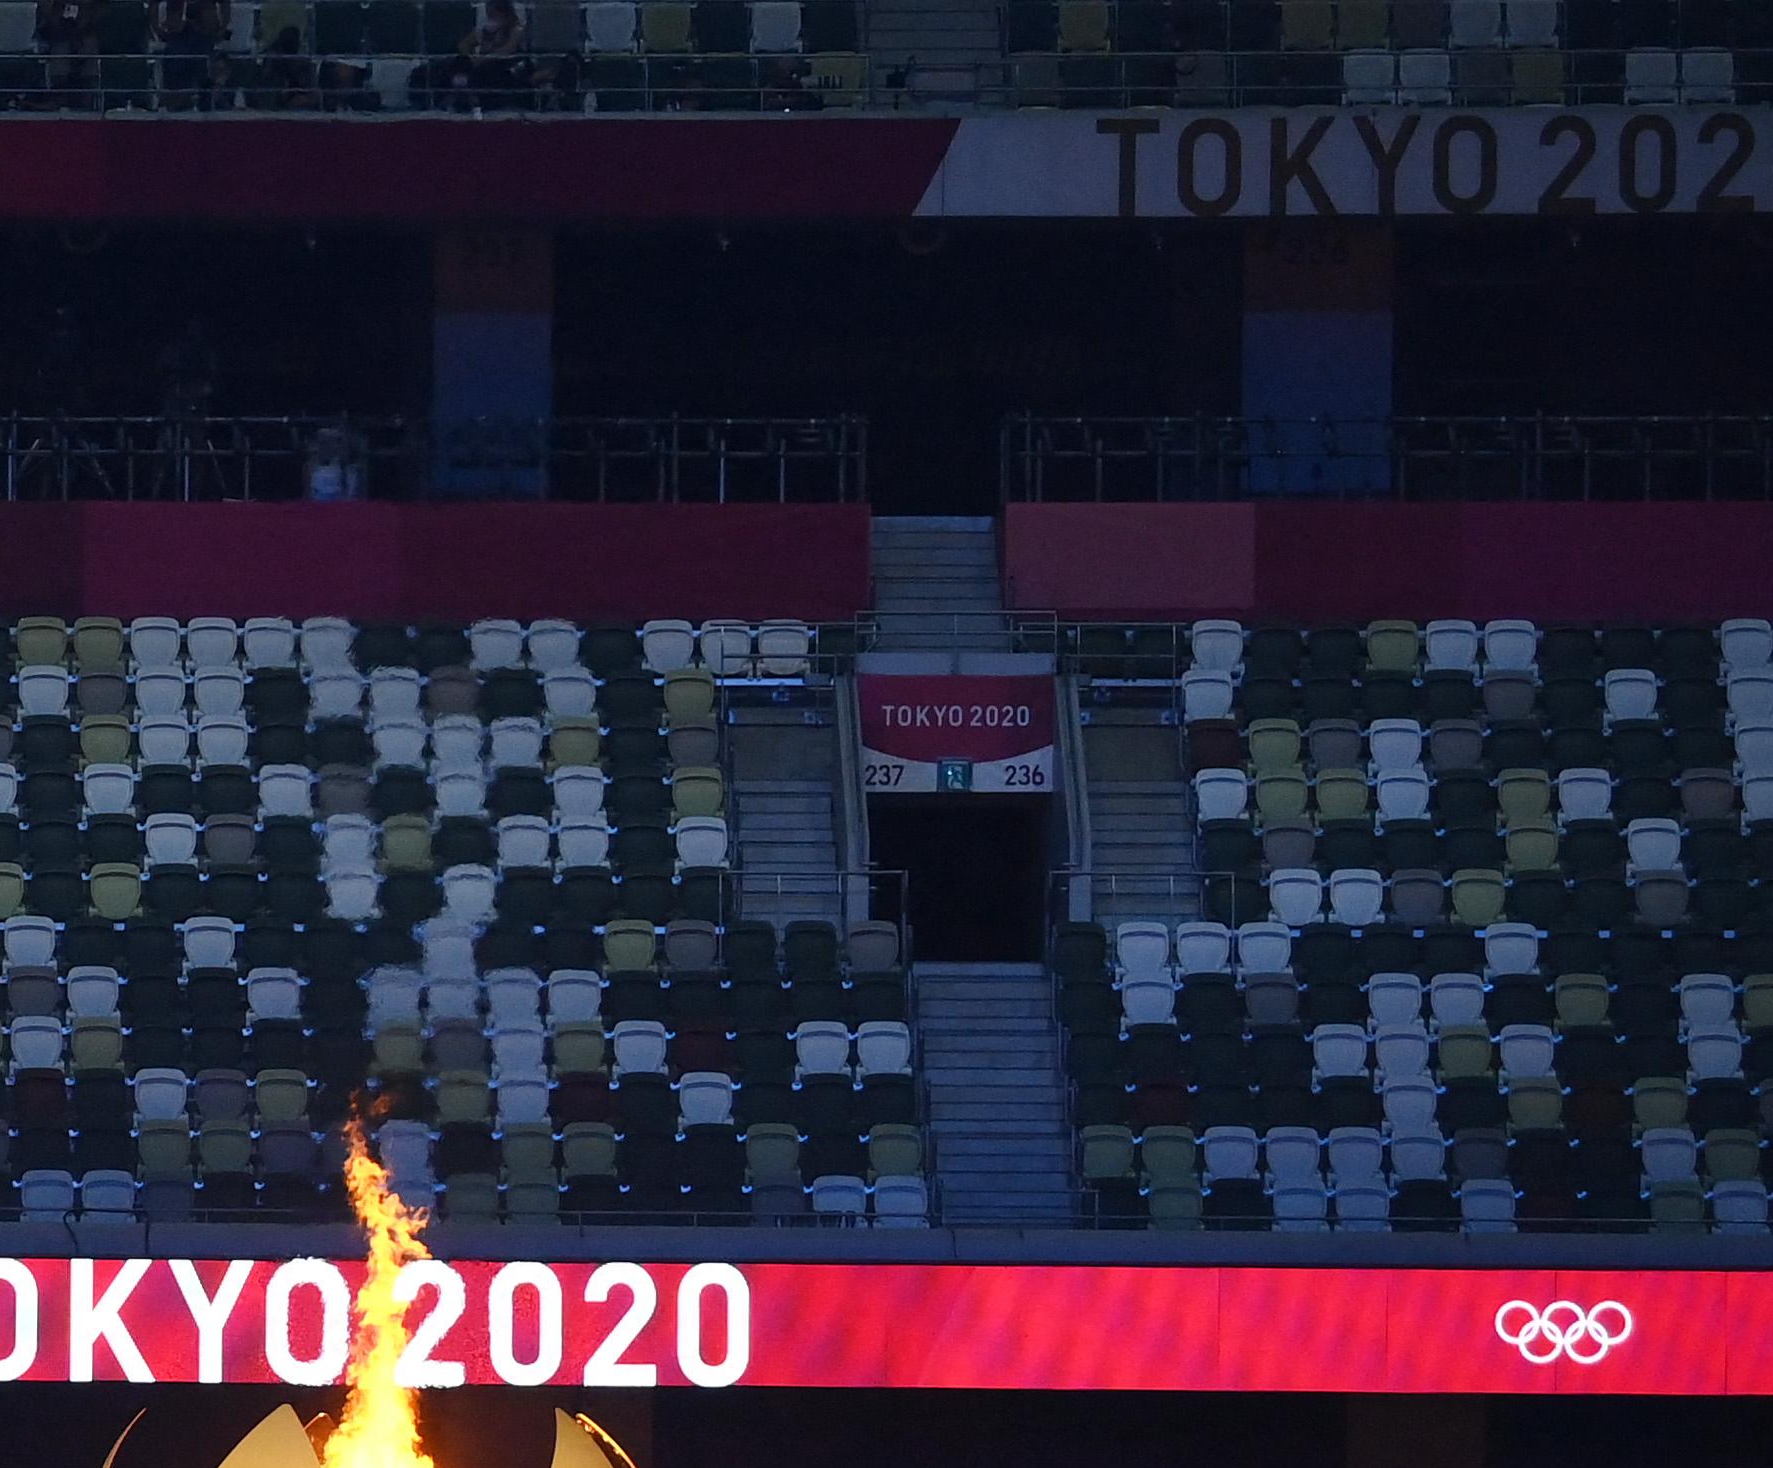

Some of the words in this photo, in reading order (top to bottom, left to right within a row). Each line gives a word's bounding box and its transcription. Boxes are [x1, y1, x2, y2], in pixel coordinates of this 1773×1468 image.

[1096, 115, 1497, 217] TOKYO
[882, 705, 962, 726] TOKYO
[969, 705, 1029, 726] 2020
[865, 765, 904, 786] 237
[1005, 765, 1044, 785] 236
[392, 1260, 751, 1387] 2020
